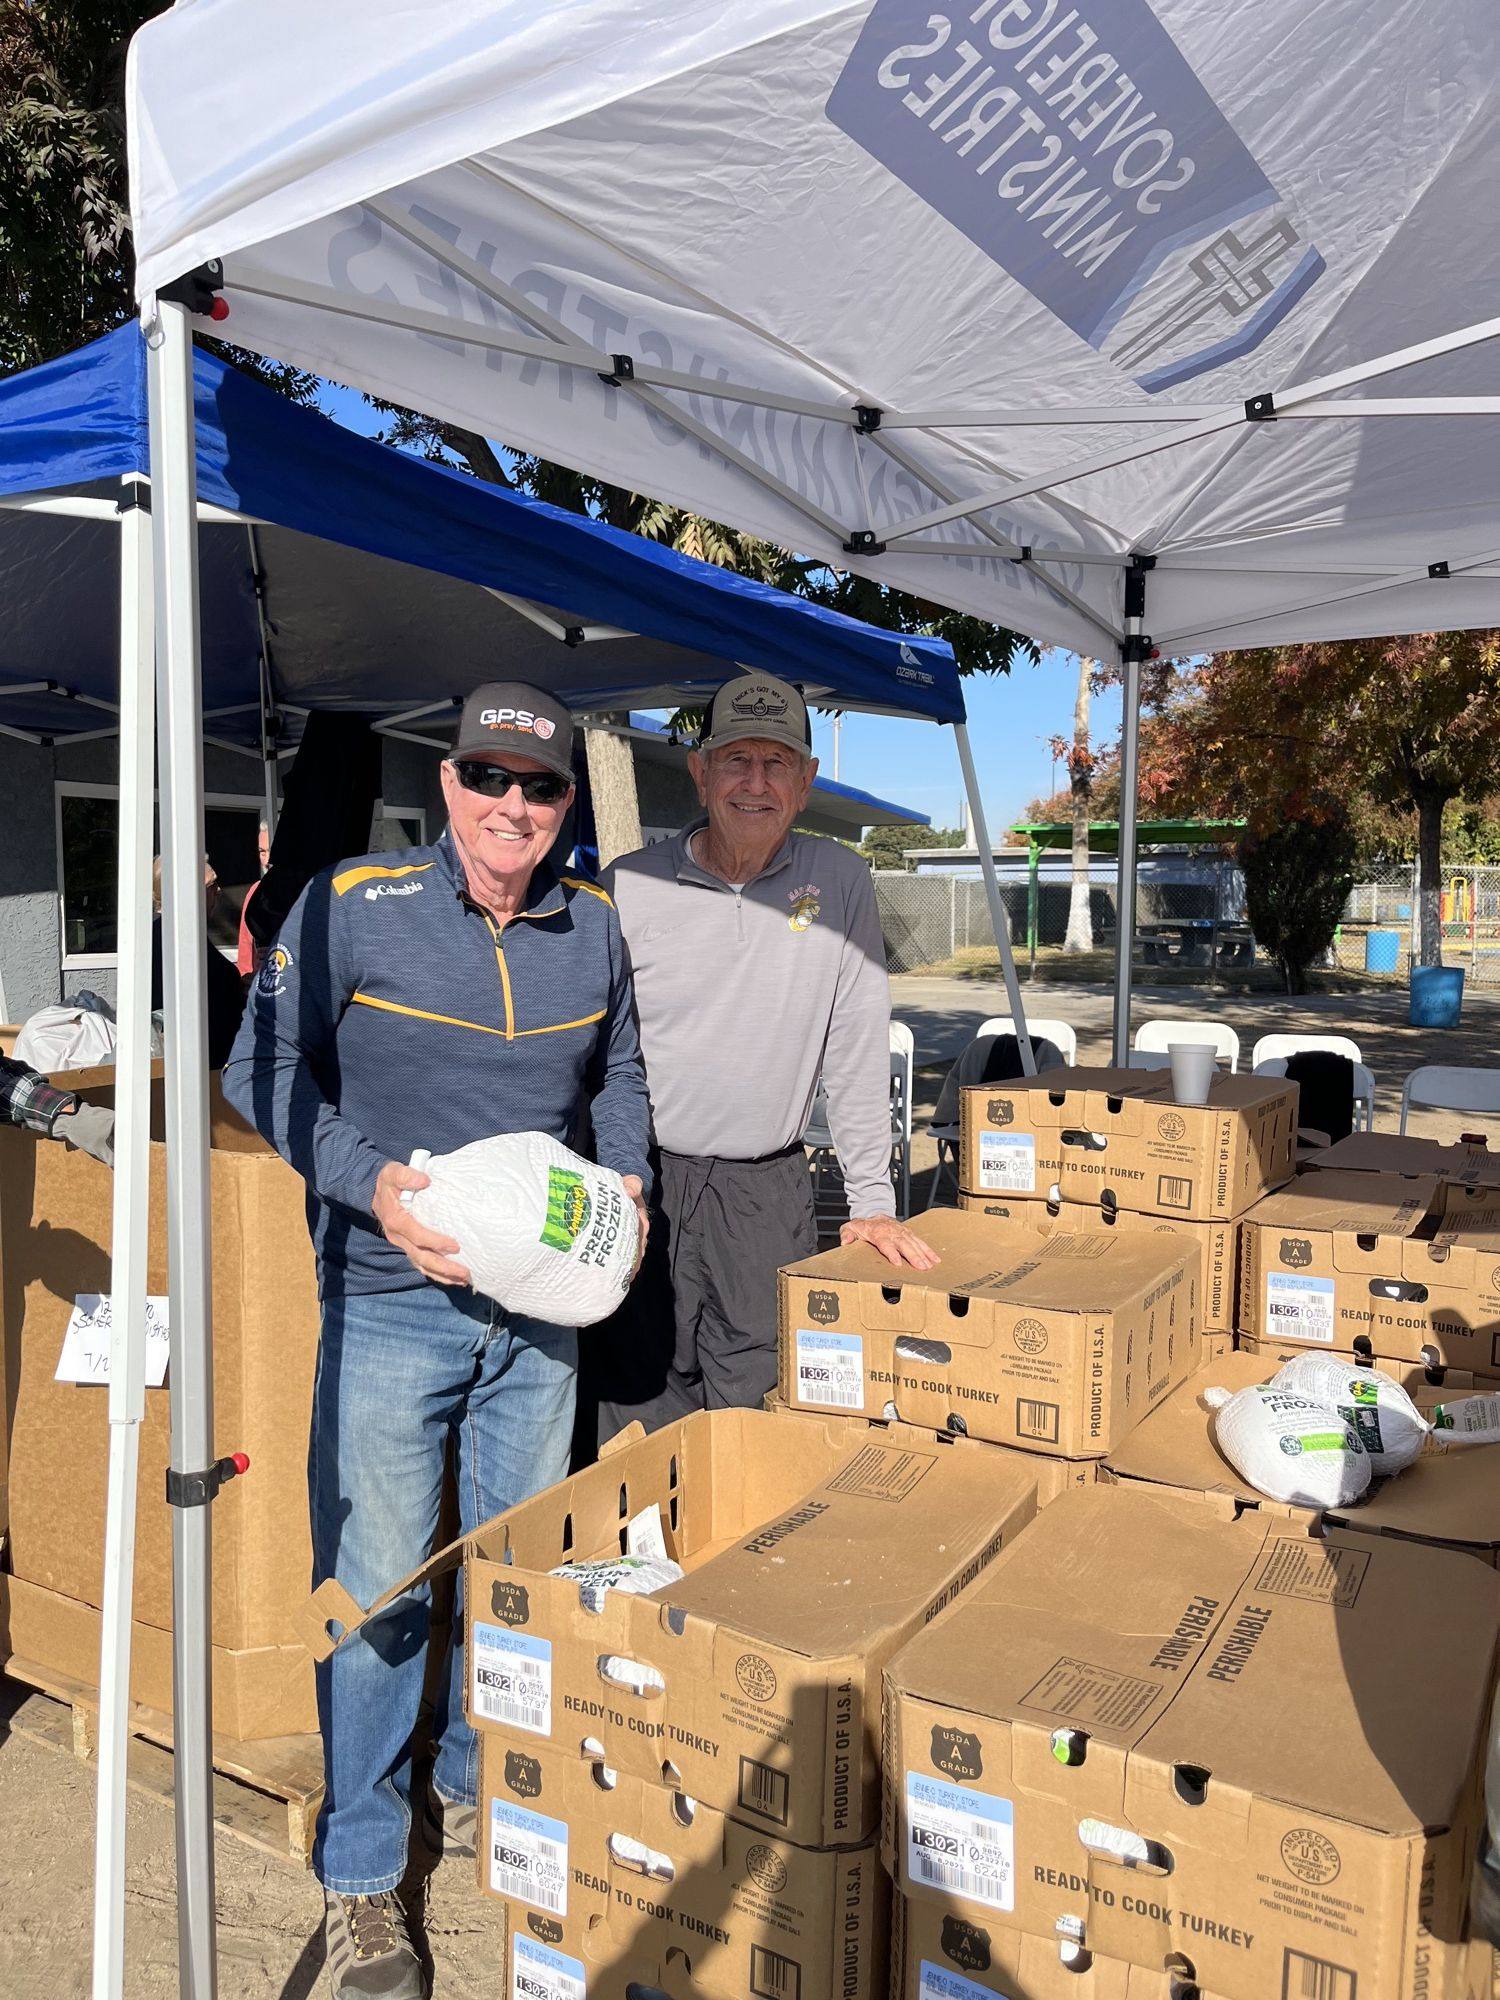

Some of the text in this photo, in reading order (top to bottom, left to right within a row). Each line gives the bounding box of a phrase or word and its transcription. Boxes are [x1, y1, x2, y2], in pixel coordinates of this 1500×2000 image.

[480, 708, 535, 727] GPS
[377, 881, 424, 897] Columbia
[1066, 1162, 1077, 1172] TO
[1081, 1164, 1106, 1175] COOK
[1109, 1167, 1145, 1181] TURKEY
[1217, 1118, 1232, 1207] PRODUCT OF U.S.A.
[578, 1181, 609, 1265] PREMIUM
[595, 1190, 621, 1268] FROZEN
[1292, 1248, 1300, 1257] A
[1214, 1257, 1224, 1271] OF
[1212, 1273, 1223, 1318] PRODUCT
[820, 1302, 827, 1311] A
[1379, 1315, 1394, 1325] TO
[1397, 1317, 1427, 1330] COOK
[1431, 1321, 1476, 1338] TURKEY
[1090, 1323, 1105, 1438] PRODUCT OF U.S.A.
[903, 1378, 918, 1389] TO
[922, 1380, 953, 1395] COOK
[956, 1386, 1000, 1404] TURKEY
[1270, 1400, 1324, 1413] FROZ
[743, 1501, 831, 1555] PERISHABLE
[552, 1570, 632, 1580] EMIUM
[500, 1586, 521, 1597] USDA
[505, 1595, 515, 1610] A
[498, 1609, 524, 1622] GRADE
[1149, 1595, 1220, 1671] PERISHABLE
[1206, 1605, 1273, 1683] PERISHABLE
[738, 1655, 775, 1683] INSPECTED
[564, 1695, 720, 1758] READY TO COOK TURKEY
[942, 1732, 970, 1746] USDA
[513, 1756, 534, 1768] USDA
[834, 1677, 852, 1830] PRODUCT OF U.S.A.
[950, 1745, 963, 1762] A
[519, 1768, 528, 1782] A
[940, 1760, 975, 1776] GRADE
[511, 1780, 536, 1794] GRADE
[1284, 1831, 1338, 1863] INSPECTED
[1256, 1873, 1271, 1883] NET
[1271, 1877, 1299, 1893] WEIGHT
[1300, 1887, 1310, 1897] TO
[1311, 1890, 1320, 1900] BE
[1321, 1893, 1353, 1911] MARKED
[1273, 1890, 1314, 1910] CONSUMER
[615, 1888, 633, 1906] TO
[637, 1897, 674, 1921] COOK
[679, 1912, 731, 1946] TURKEY
[1034, 1865, 1255, 1950] READY TO COOK TURKEY
[1259, 1897, 1282, 1911] PRIOR
[1282, 1904, 1292, 1915] TO
[1293, 1909, 1324, 1927] DISPLAY
[1324, 1919, 1340, 1932] AND
[533, 1925, 558, 1940] GRADE
[843, 1861, 862, 2000] RODUCT OF U.S.A.
[961, 1937, 971, 1951] A
[950, 1948, 983, 1968] GRADE
[1413, 1945, 1430, 2000] ODUCT
